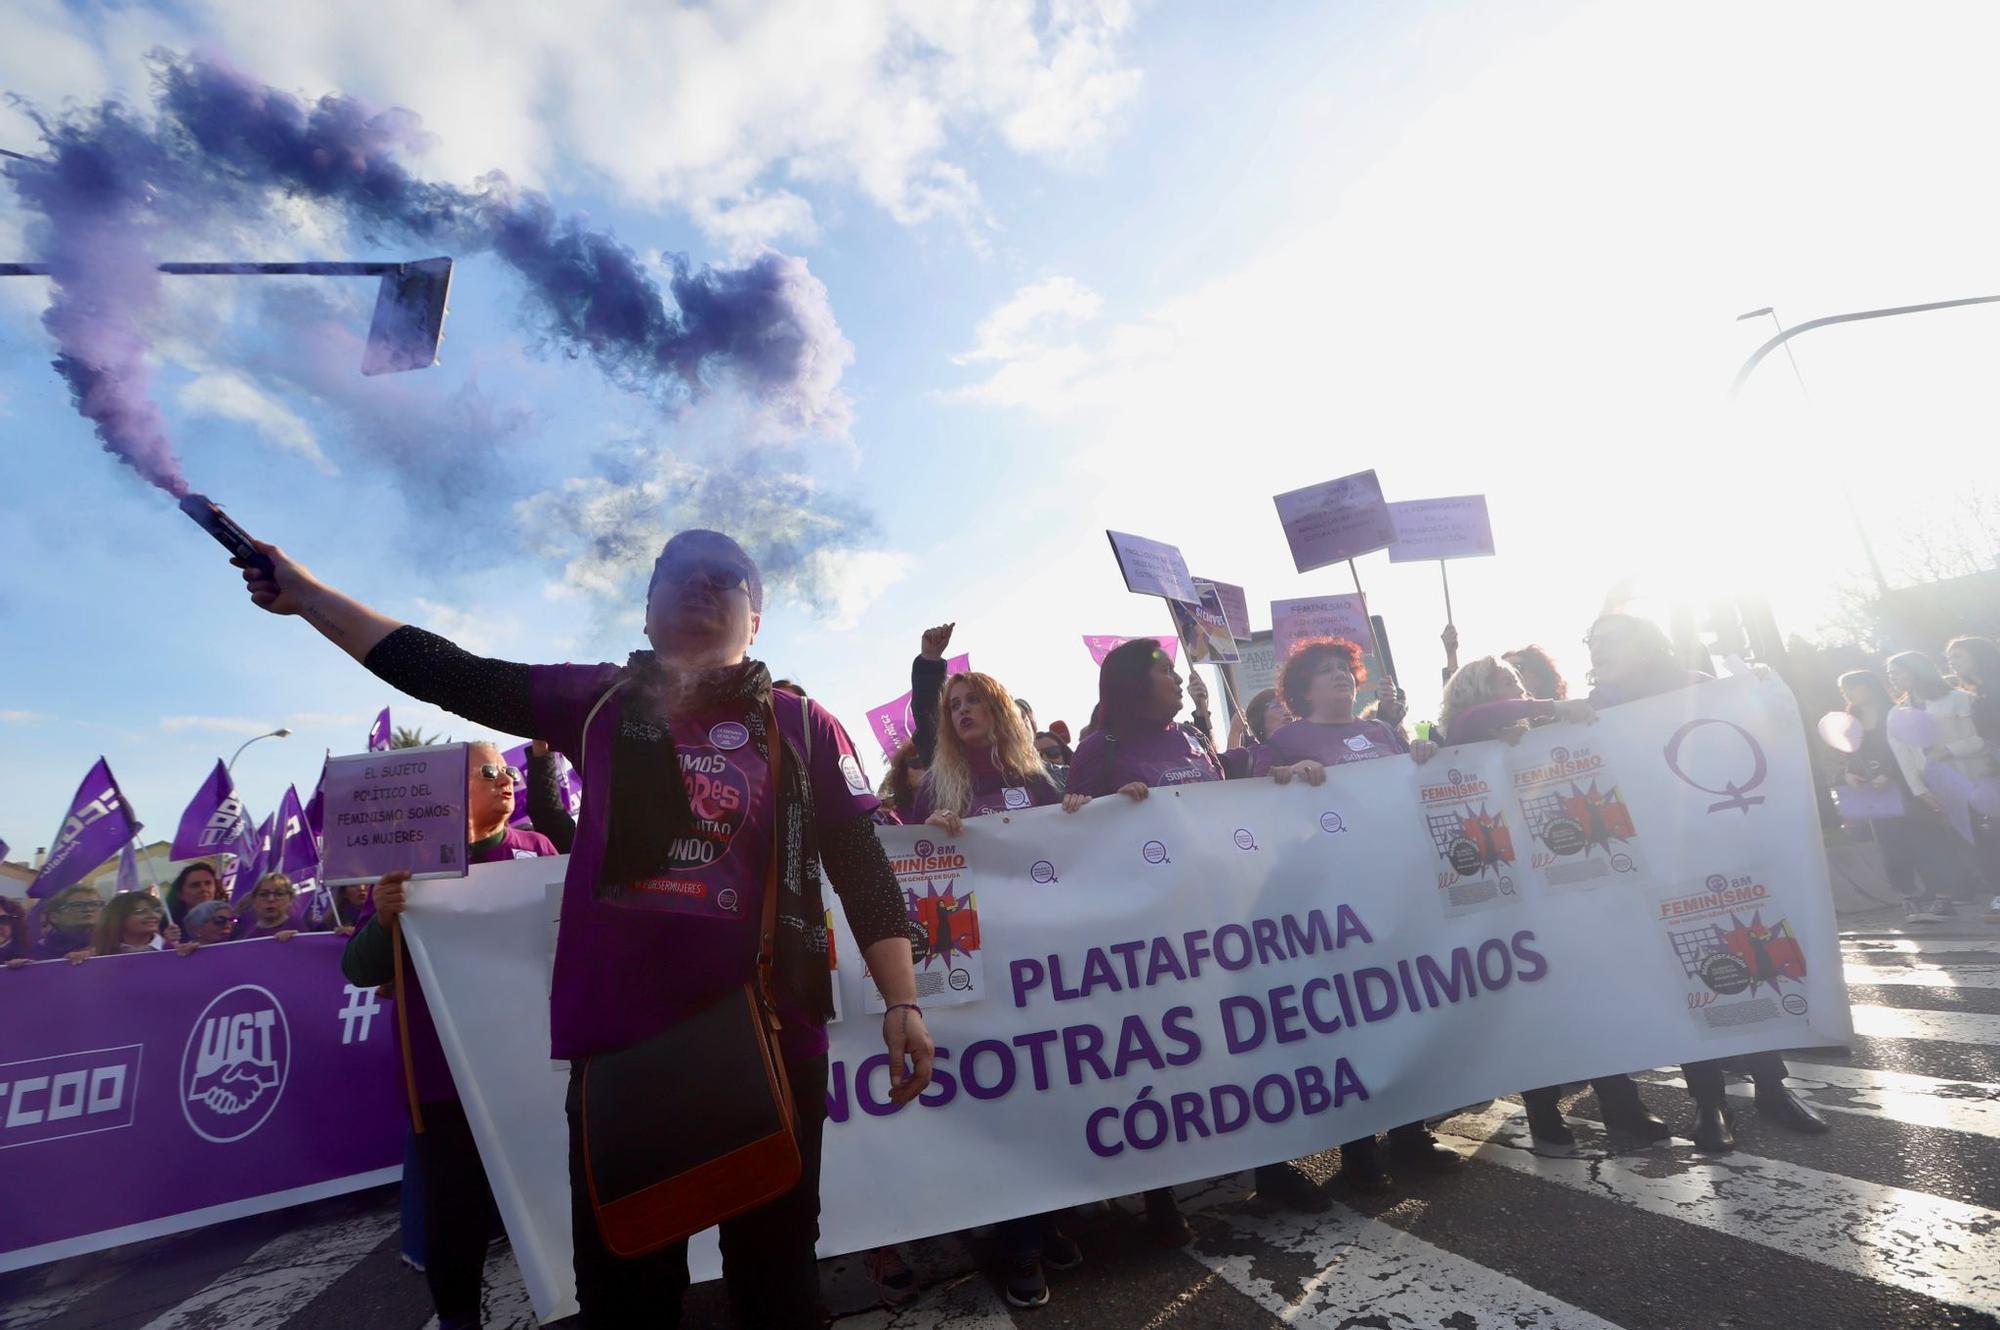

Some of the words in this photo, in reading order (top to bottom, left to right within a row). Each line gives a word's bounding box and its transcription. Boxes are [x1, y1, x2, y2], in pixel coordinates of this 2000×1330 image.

[365, 767, 378, 780] EL
[381, 761, 428, 778] SUJETO
[677, 754, 727, 774] MOS
[1165, 768, 1202, 782] SOMOS
[1513, 755, 1601, 785] FEMINISMO
[410, 784, 432, 798] DEL
[1422, 780, 1488, 801] FEMINISMO
[338, 809, 403, 827] FEMINISMO
[408, 804, 451, 820] SOMOS
[347, 834, 369, 848] LAS
[373, 830, 425, 845] MUJERES
[937, 845, 956, 855] 8M
[668, 838, 714, 863] NDO
[889, 854, 965, 873] MINISMO
[1731, 875, 1752, 888] 8M
[1660, 884, 1766, 916] FEMINISMO
[1010, 904, 1373, 1008] PLATAFORMA
[1220, 930, 1548, 1056] DECIDIMOS
[196, 1009, 276, 1077] UGT
[0, 1064, 127, 1129] COO
[1086, 1057, 1370, 1157] CÓRDOBA
